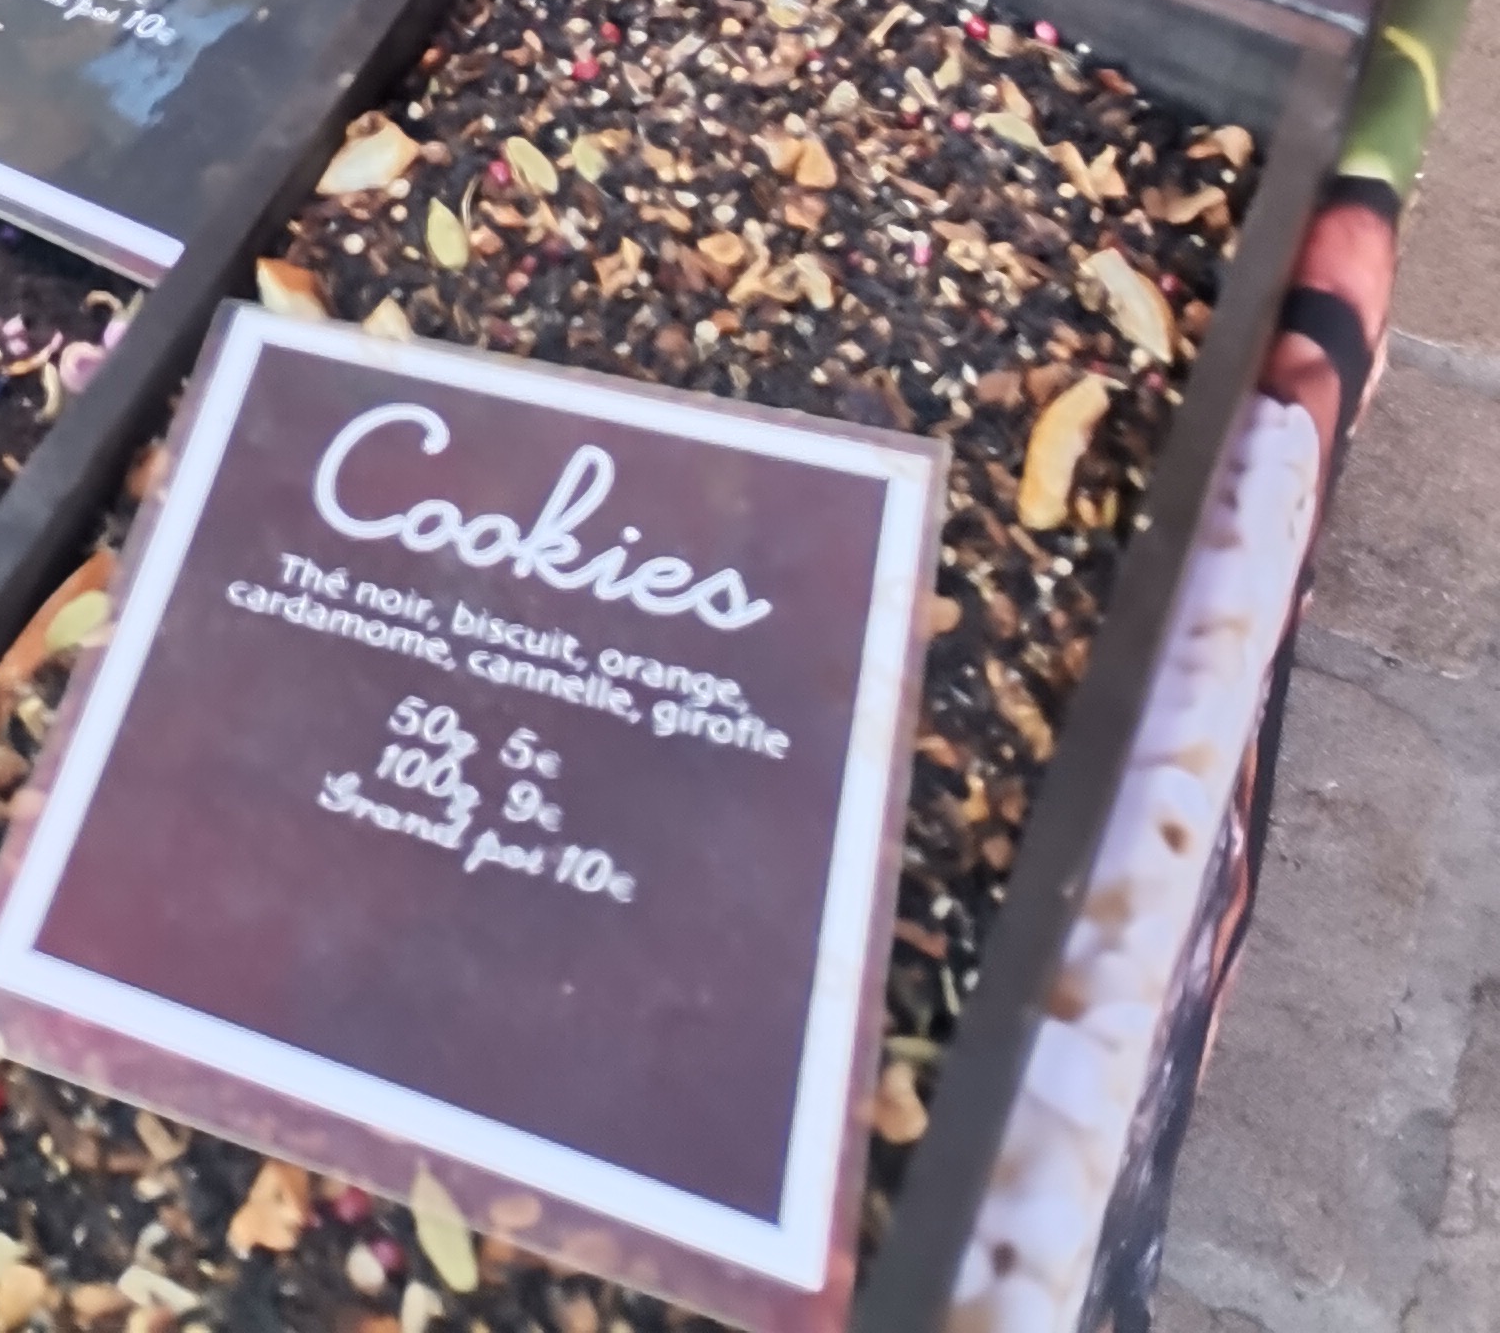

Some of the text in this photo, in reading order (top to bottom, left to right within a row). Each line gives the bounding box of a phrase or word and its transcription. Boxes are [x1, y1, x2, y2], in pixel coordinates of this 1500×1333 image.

[123, 9, 177, 46] 10€
[313, 402, 773, 630] Cookies
[226, 579, 791, 760] cardamome, cannelle, girofle
[279, 552, 750, 714] Thé noir, biscuit, orange,
[375, 743, 564, 832] 100g 9€
[388, 694, 563, 779] 50g 5€
[317, 770, 638, 904] Grand pot 10€
